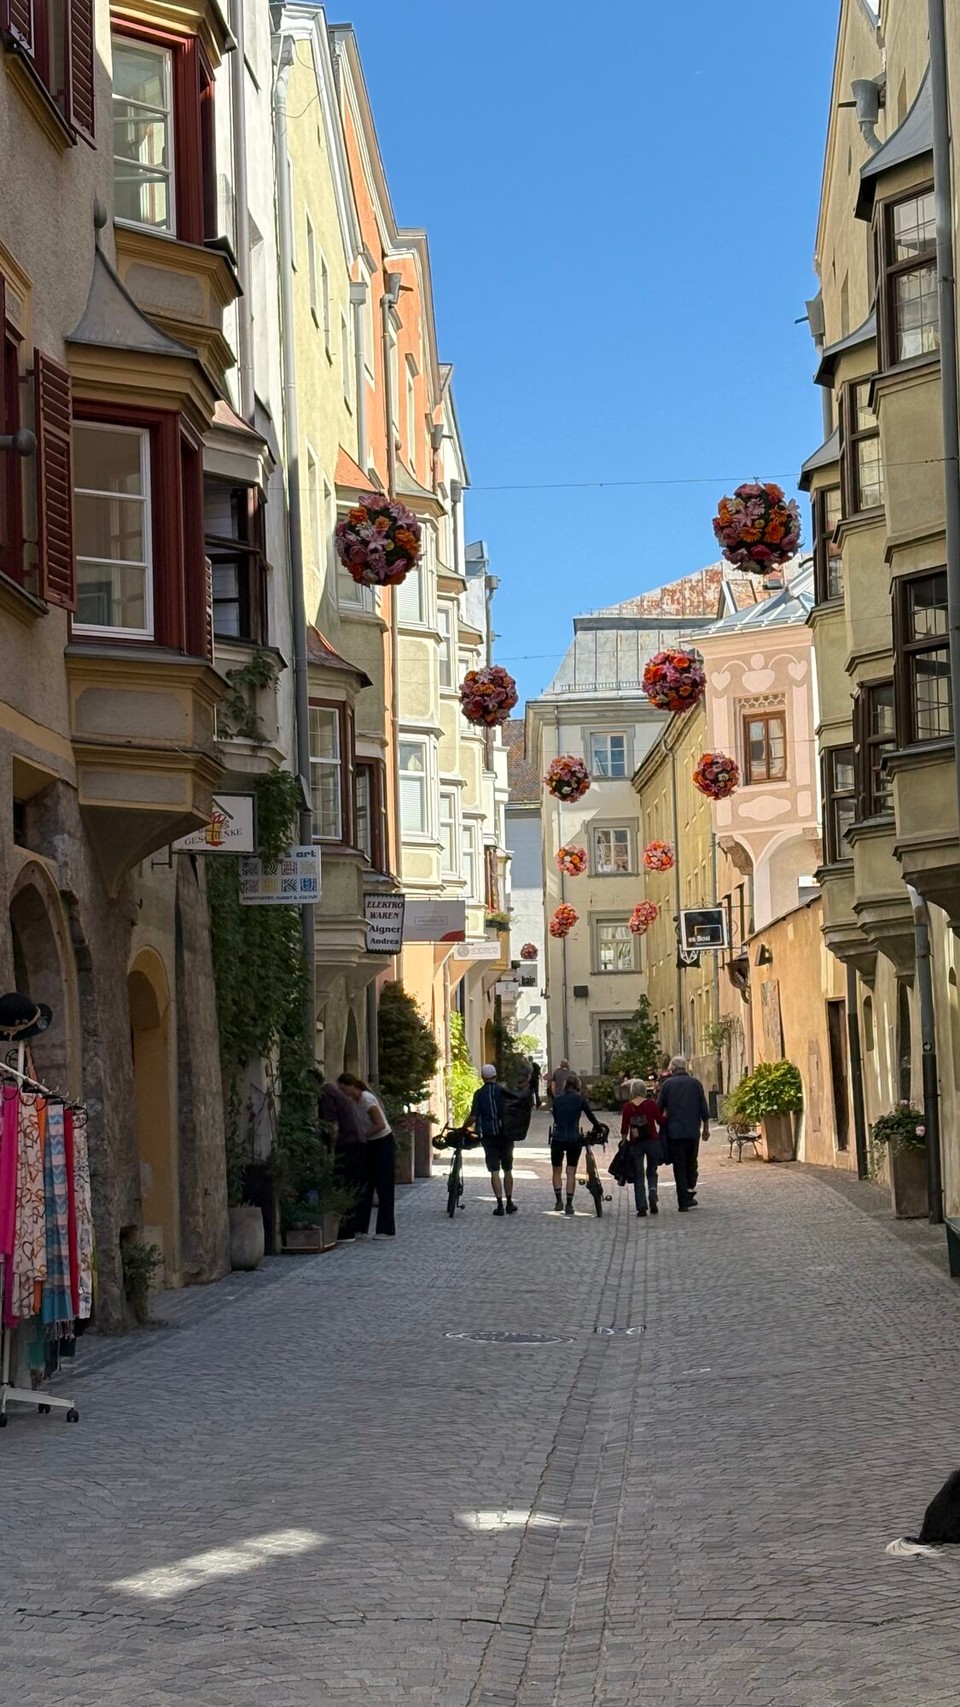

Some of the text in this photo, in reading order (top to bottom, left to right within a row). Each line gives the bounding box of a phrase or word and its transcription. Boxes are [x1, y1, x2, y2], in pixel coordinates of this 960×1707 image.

[184, 828, 243, 846] GESNKE
[296, 849, 317, 858] art
[366, 900, 404, 909] ELEKTRO
[369, 911, 399, 920] WAREN
[368, 924, 401, 935] Aigner
[370, 937, 399, 945] Andrea
